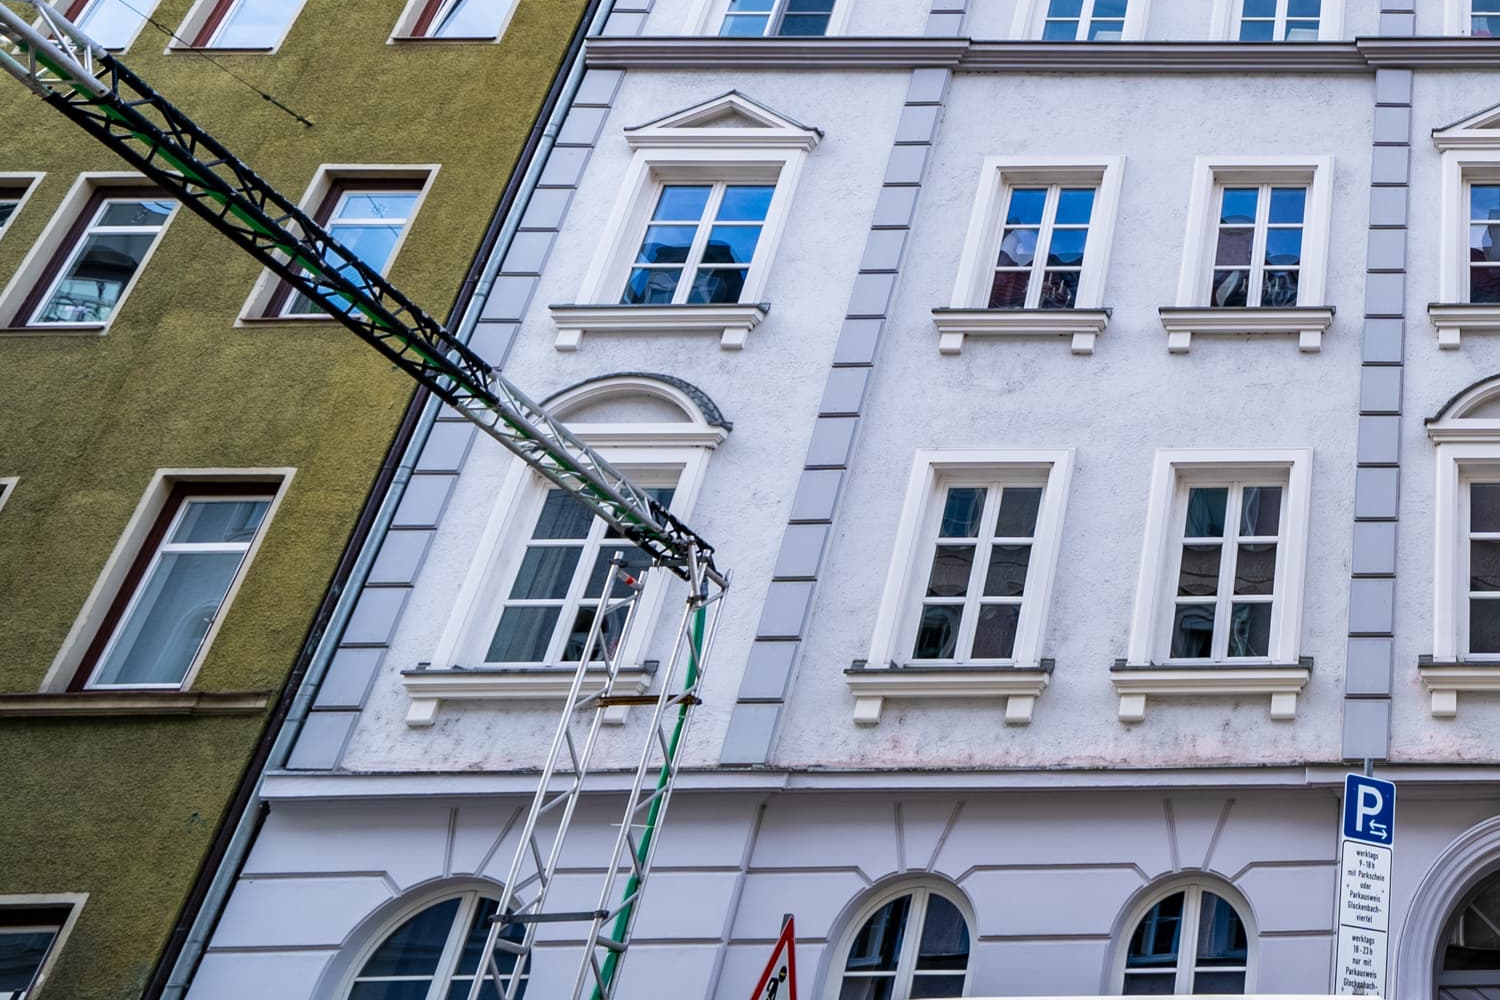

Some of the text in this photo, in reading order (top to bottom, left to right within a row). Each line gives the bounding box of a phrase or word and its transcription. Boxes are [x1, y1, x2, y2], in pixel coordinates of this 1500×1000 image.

[1355, 784, 1383, 832] P
[1356, 851, 1379, 860] werktags
[1358, 870, 1385, 881] Parkschein
[1360, 882, 1371, 890] oder
[1349, 890, 1381, 903] Parkausweis
[1347, 900, 1382, 913] Glockenbach-
[1356, 915, 1373, 923] viertel
[1352, 936, 1374, 945] werktags
[1346, 966, 1376, 978] Parkausweis
